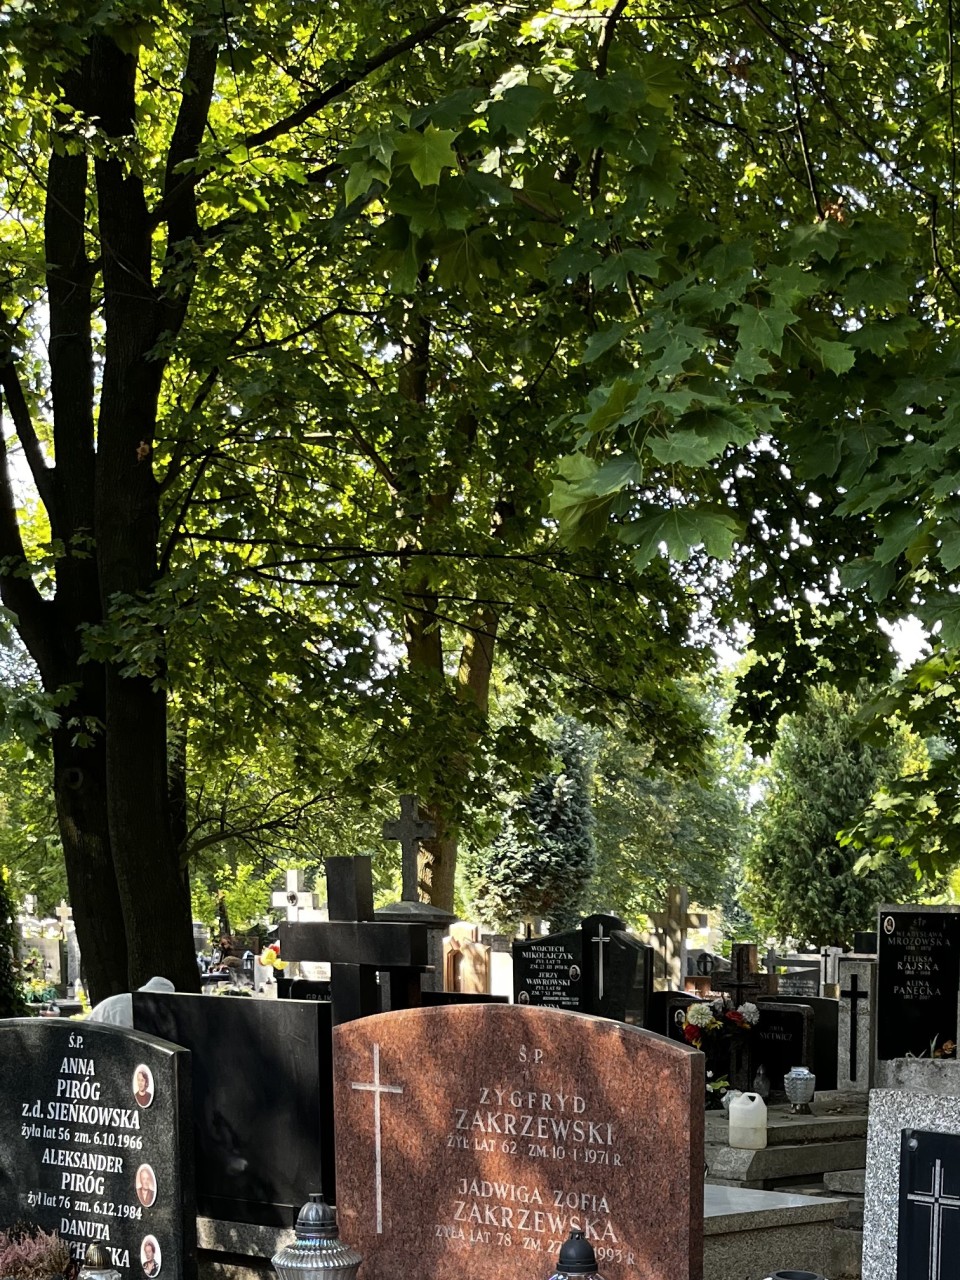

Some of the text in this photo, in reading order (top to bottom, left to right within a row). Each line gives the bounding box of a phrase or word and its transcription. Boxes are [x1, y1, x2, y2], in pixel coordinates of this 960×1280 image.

[521, 951, 574, 960] MIKOŁAJCZYK
[530, 945, 565, 953] WOJCIECH
[897, 961, 939, 971] RAJSKA
[60, 1057, 95, 1076] ANNA
[56, 1076, 101, 1101] PIRÓG
[479, 1087, 586, 1114] ZYGFRYD
[22, 1099, 140, 1129] z.d. SIEŃKOWSKA
[21, 1123, 143, 1150] żyła lat 56 zm. 6.10.1966
[455, 1108, 613, 1146] ZAKRZEWSKI
[475, 1137, 496, 1151] LAT
[501, 1140, 518, 1155] 62
[528, 1144, 549, 1158] ZM.
[42, 1148, 123, 1174] ALEKSANDER
[61, 1171, 105, 1196] PIRÓG
[458, 1178, 611, 1214] JADWIGA ZOFIA
[27, 1191, 143, 1220] żył lat 76 zm. 6.12.1984
[60, 1218, 110, 1241] DANUTA
[453, 1200, 618, 1243] ZAKRZEWSKA
[470, 1229, 491, 1244] LAT
[497, 1232, 512, 1247] 78
